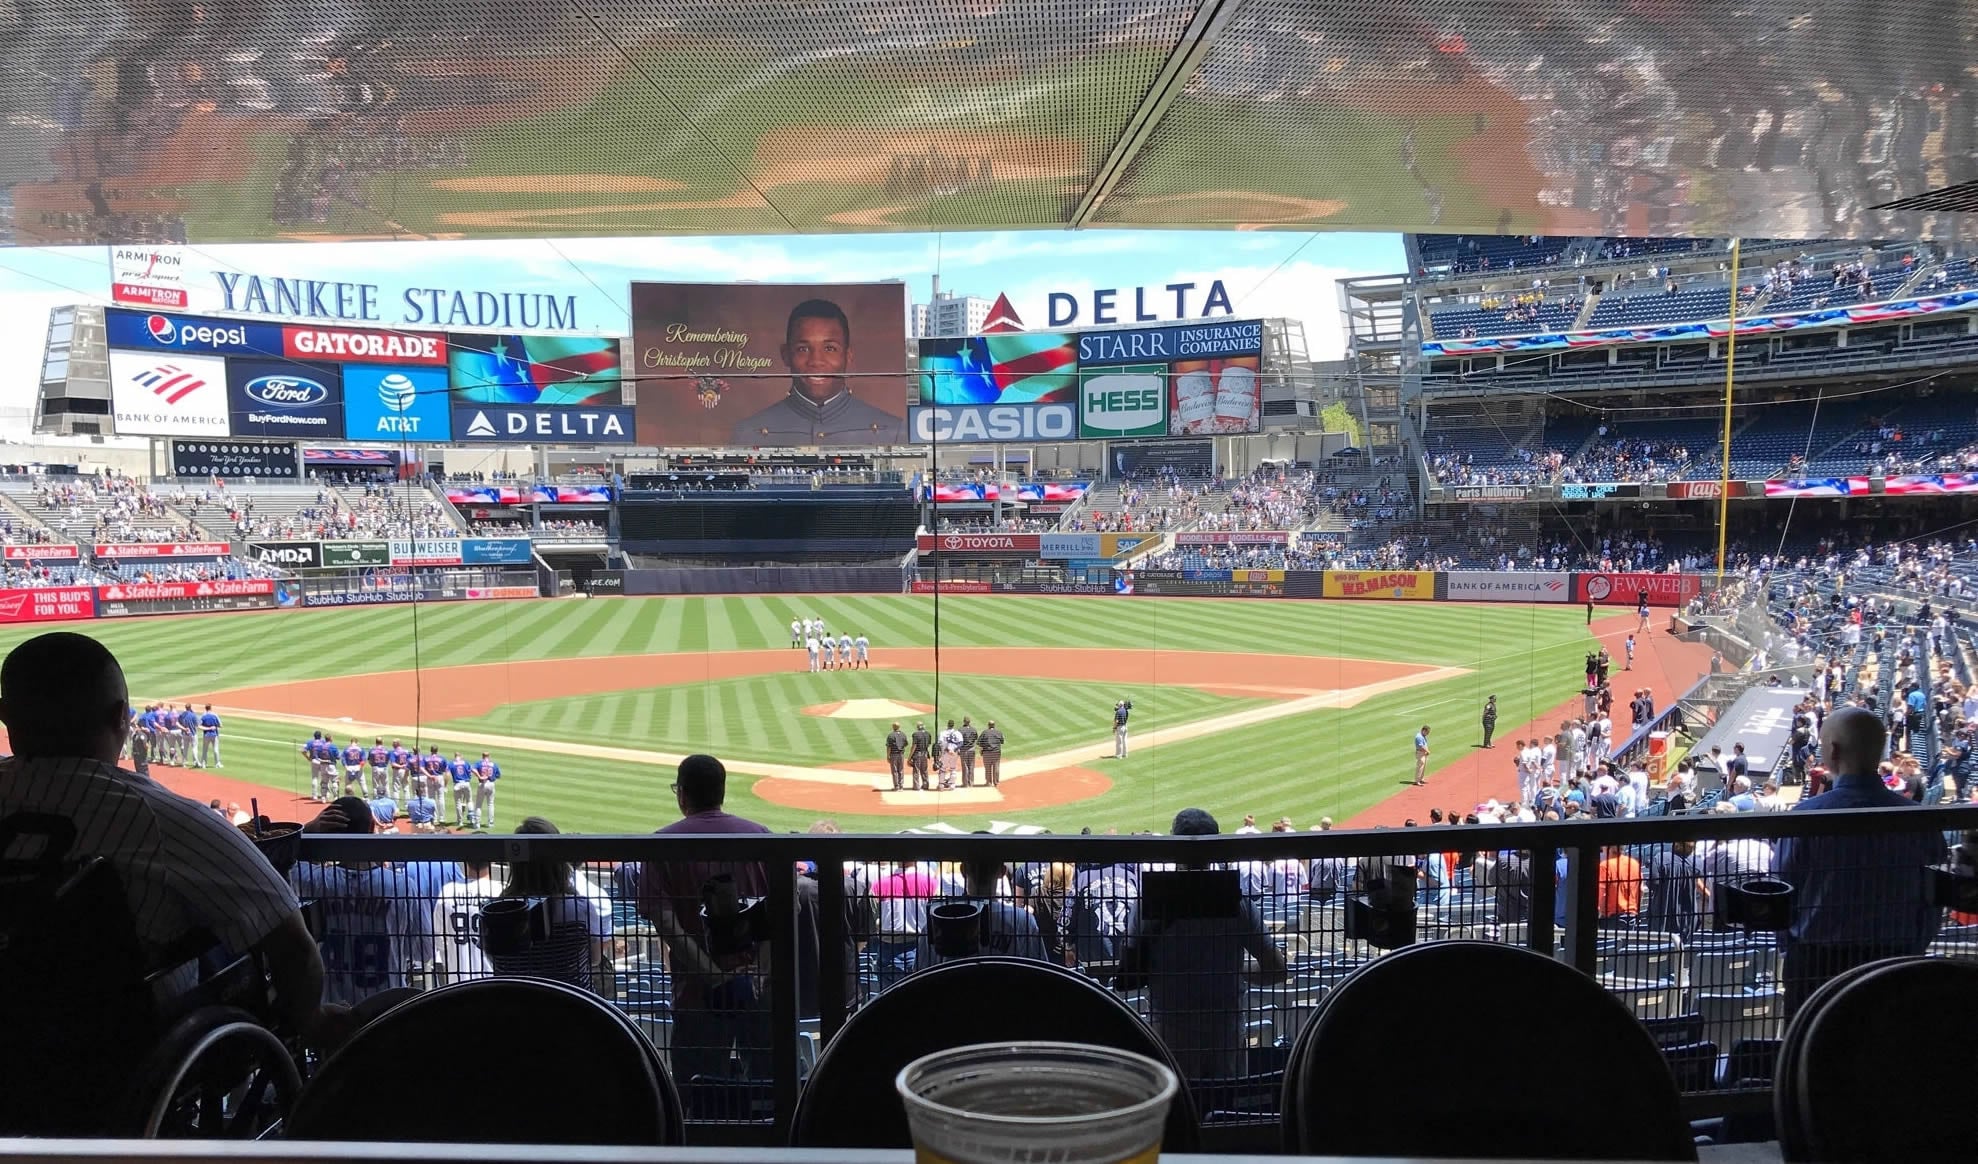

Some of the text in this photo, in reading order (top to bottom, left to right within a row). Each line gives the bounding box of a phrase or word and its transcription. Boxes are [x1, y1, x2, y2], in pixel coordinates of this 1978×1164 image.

[116, 250, 181, 266] ARMITRON
[122, 286, 181, 299] ARMITRON
[210, 271, 578, 330] YANKEE STADIUM
[1048, 279, 1235, 328] DELTA
[182, 325, 247, 349] pepsi
[665, 324, 750, 348] Remembering
[1179, 324, 1262, 342] INSURANCE
[294, 331, 438, 358] GATORADE
[1080, 333, 1170, 360] STARR
[1179, 338, 1262, 355] COMPANIES
[643, 348, 773, 373] Christopher Morgan
[262, 379, 312, 402] Ford
[1088, 388, 1159, 413] HESS
[117, 413, 226, 425] BANK OF AMERICA
[249, 413, 328, 425] BuyFordNow.com
[377, 416, 421, 433] AT&T
[507, 412, 625, 435] DELTA
[916, 406, 1073, 441] CASIO
[1456, 486, 1525, 498] Parts Authority
[394, 541, 459, 554] BUDWEISER
[965, 537, 1014, 548] TOYOTA
[259, 548, 297, 562] AMD
[1040, 584, 1106, 593] StubHub StubHub
[1450, 582, 1541, 591] BANK OF AMERICA
[34, 591, 91, 603] THIS BUD'S
[307, 591, 425, 605] StubHub StubHub StubHub
[35, 603, 81, 616] FOR YOU.
